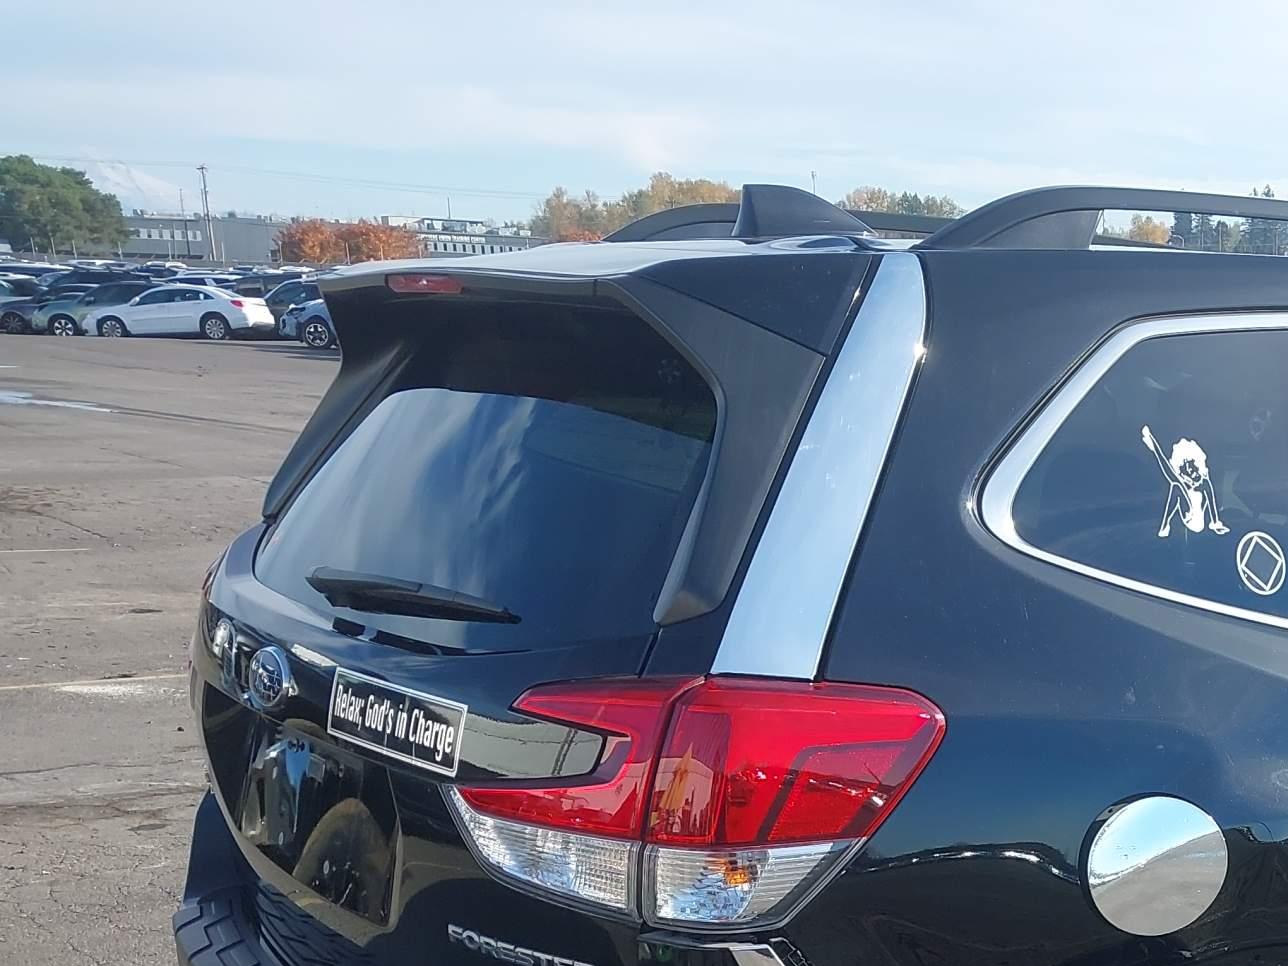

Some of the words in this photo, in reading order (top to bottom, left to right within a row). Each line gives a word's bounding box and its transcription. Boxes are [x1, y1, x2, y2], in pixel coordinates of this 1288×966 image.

[334, 684, 365, 731] Relax;
[365, 694, 394, 734] God's
[395, 704, 408, 739] in
[409, 708, 455, 761] Charge
